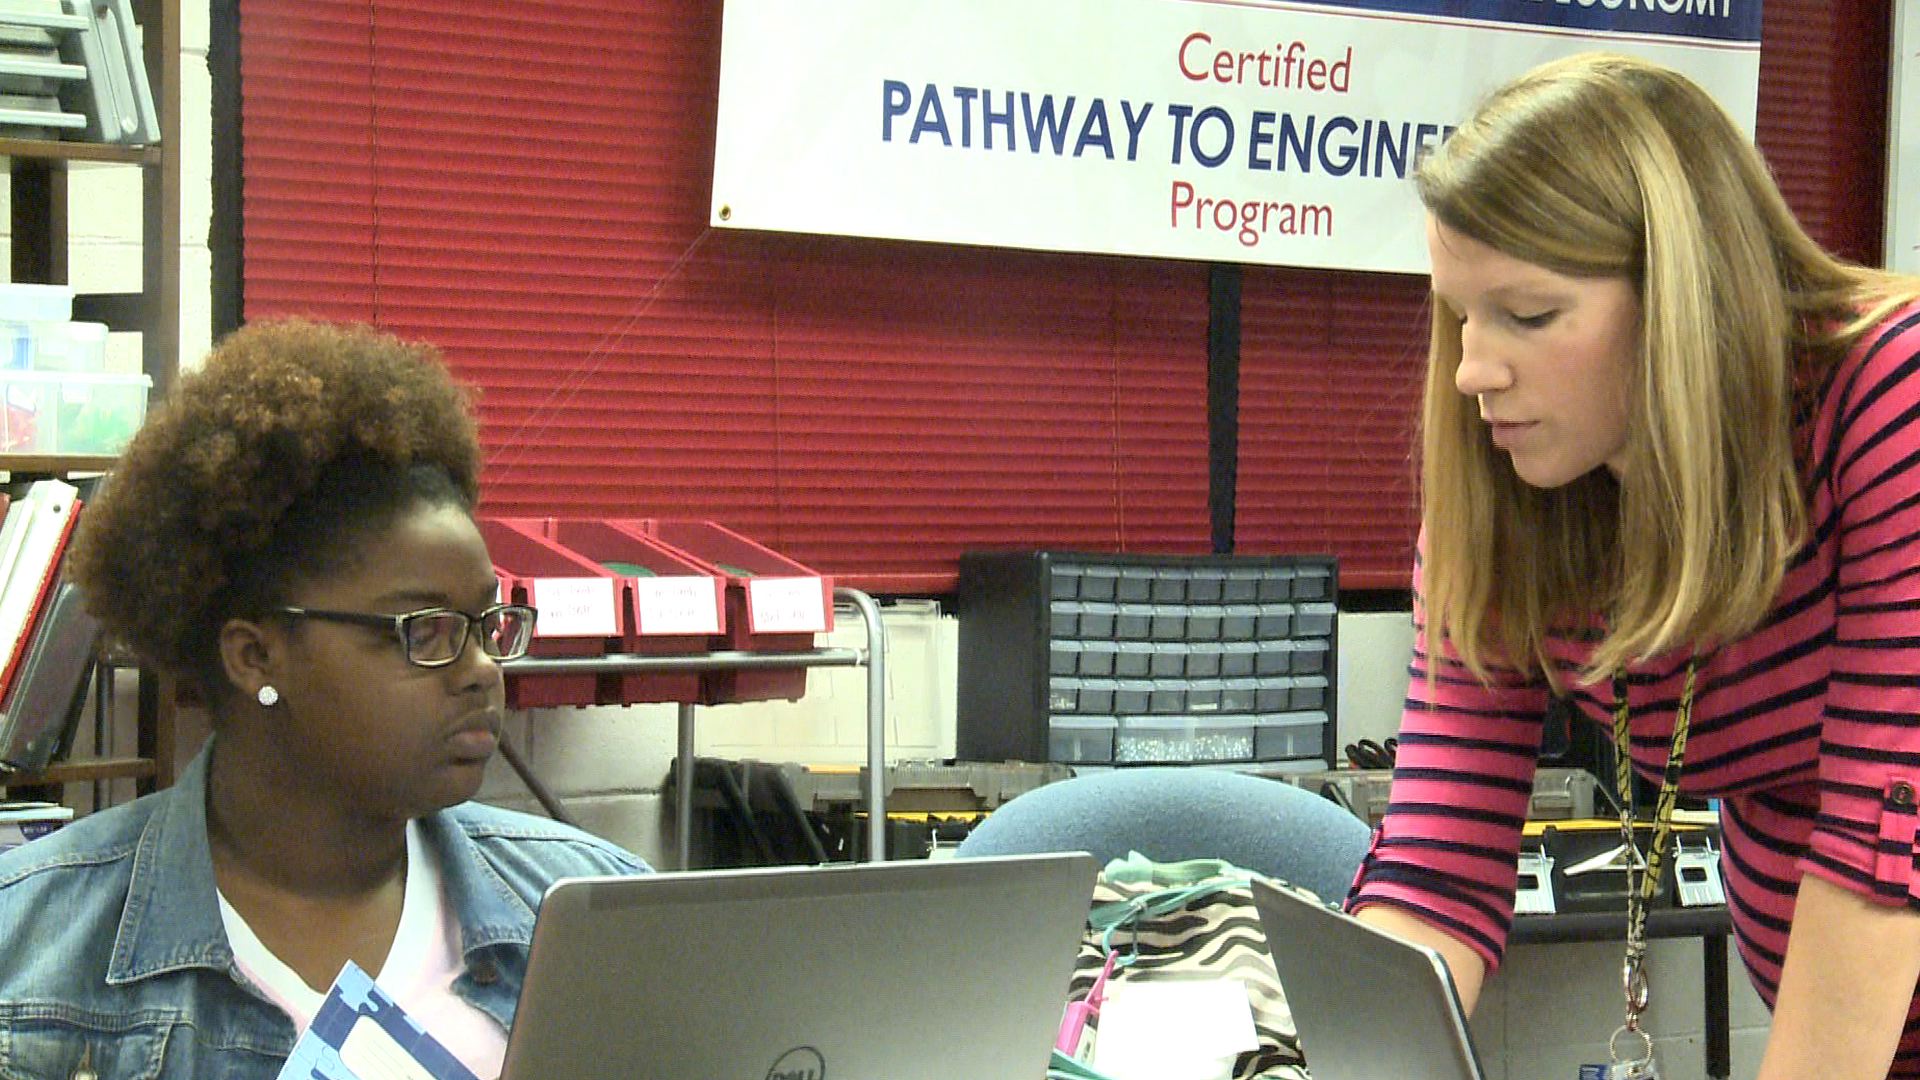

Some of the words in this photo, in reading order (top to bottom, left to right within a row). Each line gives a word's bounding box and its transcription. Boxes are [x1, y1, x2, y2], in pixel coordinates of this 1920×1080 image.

[1555, 0, 1734, 18] NOMY
[1178, 32, 1353, 93] Certified
[882, 79, 1154, 162] PATHWAY
[1167, 104, 1236, 168] TO
[1171, 181, 1334, 247] Program
